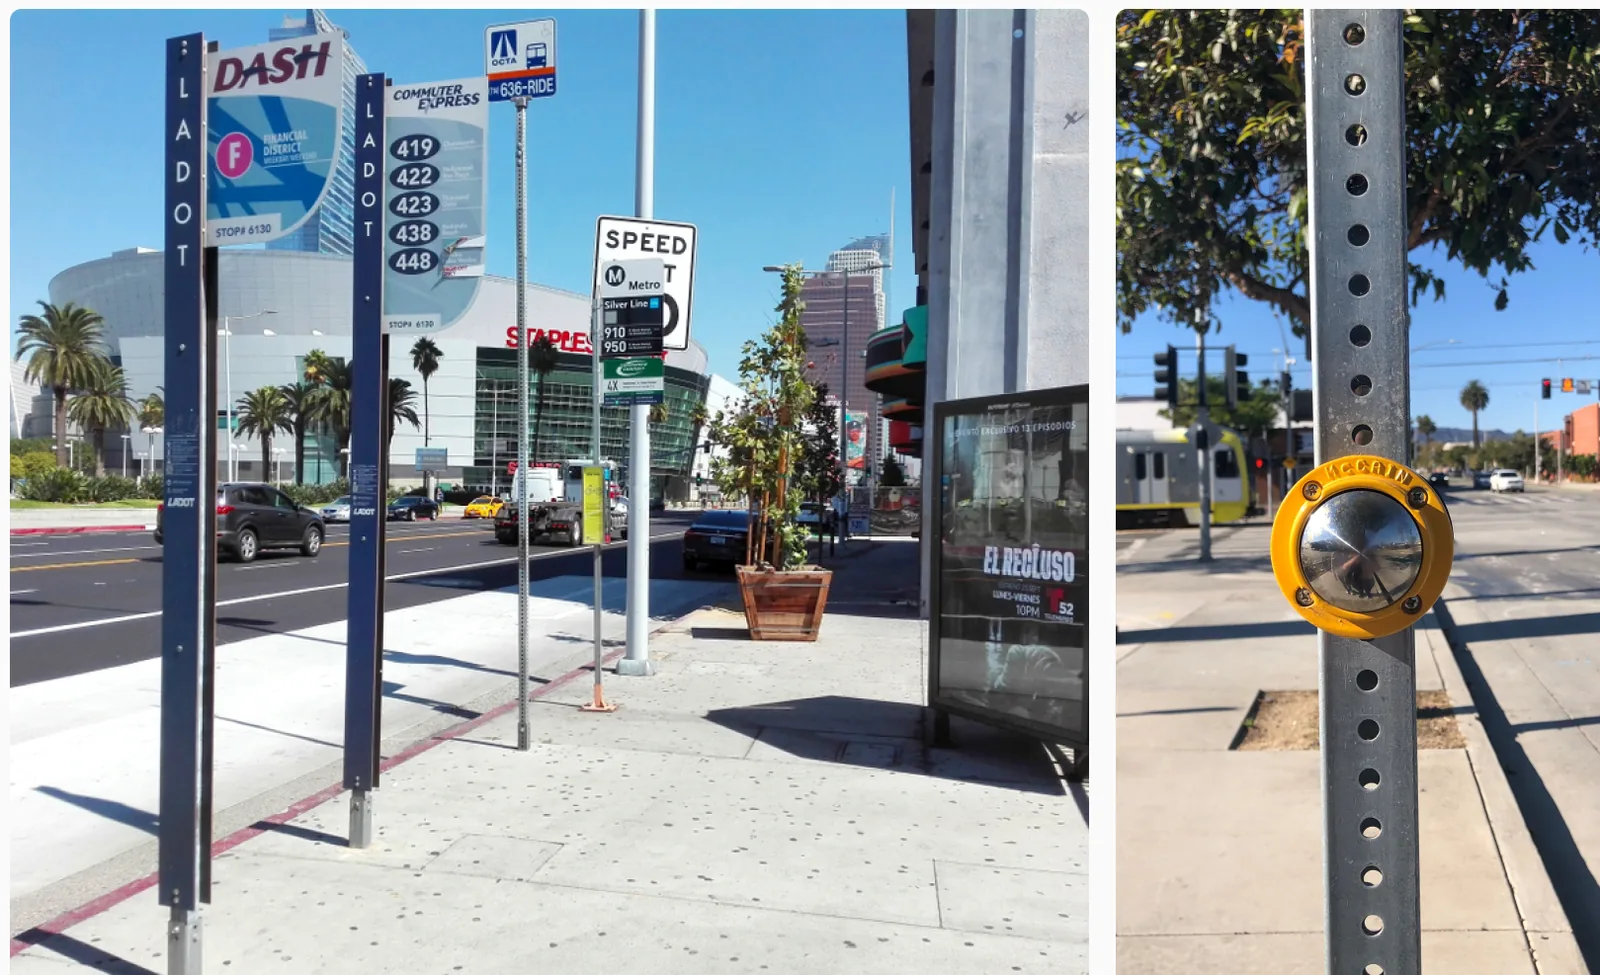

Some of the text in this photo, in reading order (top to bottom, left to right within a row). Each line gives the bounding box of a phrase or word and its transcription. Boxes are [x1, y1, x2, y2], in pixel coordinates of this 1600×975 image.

[213, 41, 332, 93] DASH
[491, 57, 517, 66] OCTA
[393, 84, 463, 101] COMMUTER
[500, 77, 554, 98] 636-RIDE
[418, 92, 481, 110] EXPRESS
[263, 130, 309, 144] FINANCIAL
[228, 141, 242, 170] F
[263, 142, 302, 156] DISTRICT
[396, 138, 433, 157] 419
[396, 167, 432, 186] 422
[396, 196, 432, 214] 423
[215, 224, 272, 239] STOP# 6130
[396, 224, 432, 242] 438
[605, 230, 687, 255] SPEED
[395, 252, 432, 270] 448
[607, 267, 623, 284] M
[629, 280, 661, 290] Metro
[604, 299, 648, 309] Silver Line
[604, 327, 626, 338] 910
[604, 341, 627, 352] 950
[1021, 424, 1031, 433] 13
[1032, 421, 1077, 433] EPISODIOS
[984, 545, 1075, 582] EL RECLUSO
[1016, 604, 1040, 618] 10PM
[1059, 601, 1074, 616] 52
